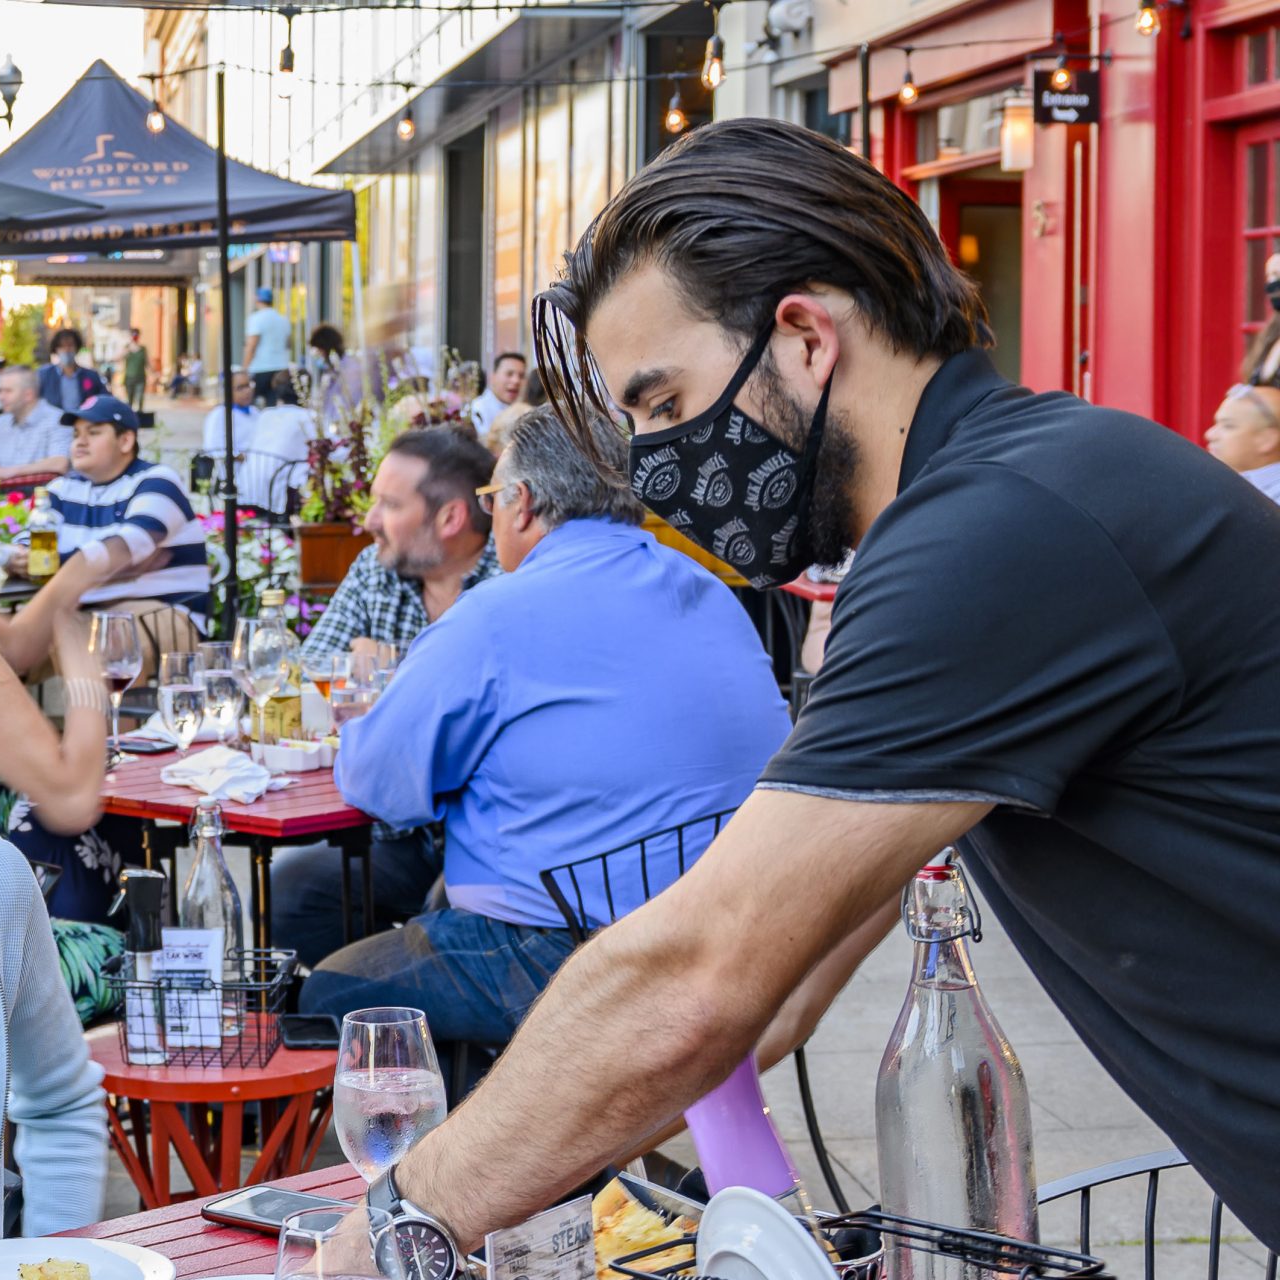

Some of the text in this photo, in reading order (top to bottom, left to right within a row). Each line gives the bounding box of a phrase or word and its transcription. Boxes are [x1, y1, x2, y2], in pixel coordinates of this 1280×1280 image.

[32, 160, 190, 179] WOODFORD
[50, 174, 179, 191] RESERVE
[133, 219, 246, 238] RESERE
[725, 411, 744, 445] JACK
[631, 466, 649, 499] JACK
[690, 474, 709, 506] JACK
[744, 449, 796, 511] JACK DANIEL'S
[552, 1221, 591, 1254] STEAK
